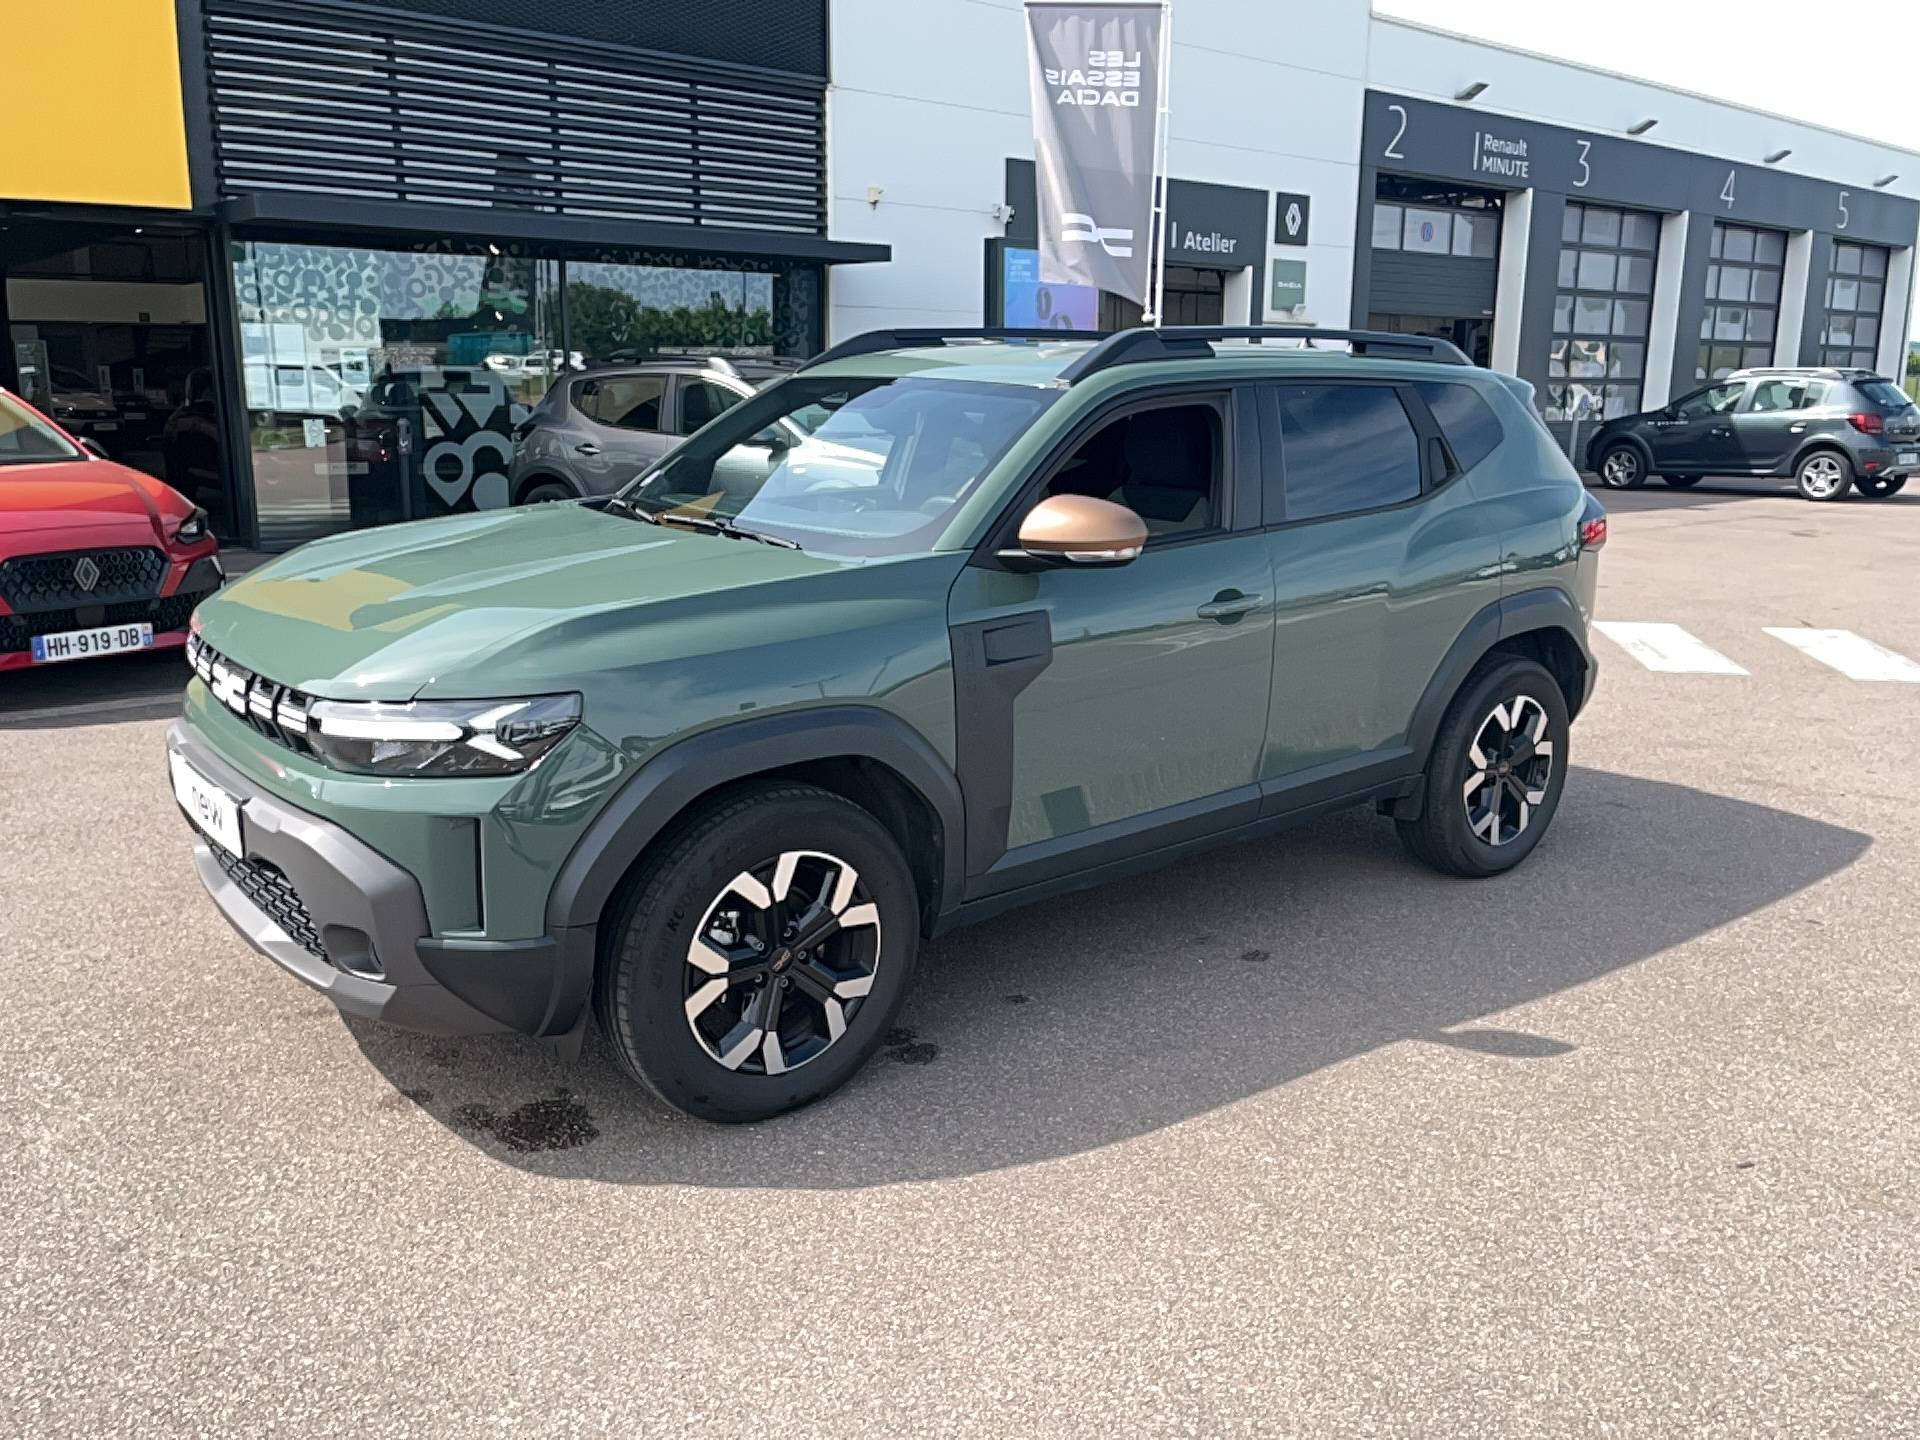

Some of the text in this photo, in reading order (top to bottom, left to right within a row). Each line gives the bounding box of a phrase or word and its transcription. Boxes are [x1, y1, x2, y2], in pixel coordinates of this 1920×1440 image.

[1384, 104, 1408, 160] 2
[1484, 133, 1528, 157] Renault
[1481, 155, 1529, 179] MINUTE
[1572, 139, 1592, 188] 3
[1719, 169, 1736, 210] 4
[1836, 191, 1852, 230] 5
[1183, 230, 1237, 254] Atelier
[46, 627, 140, 658] HH-919-DB
